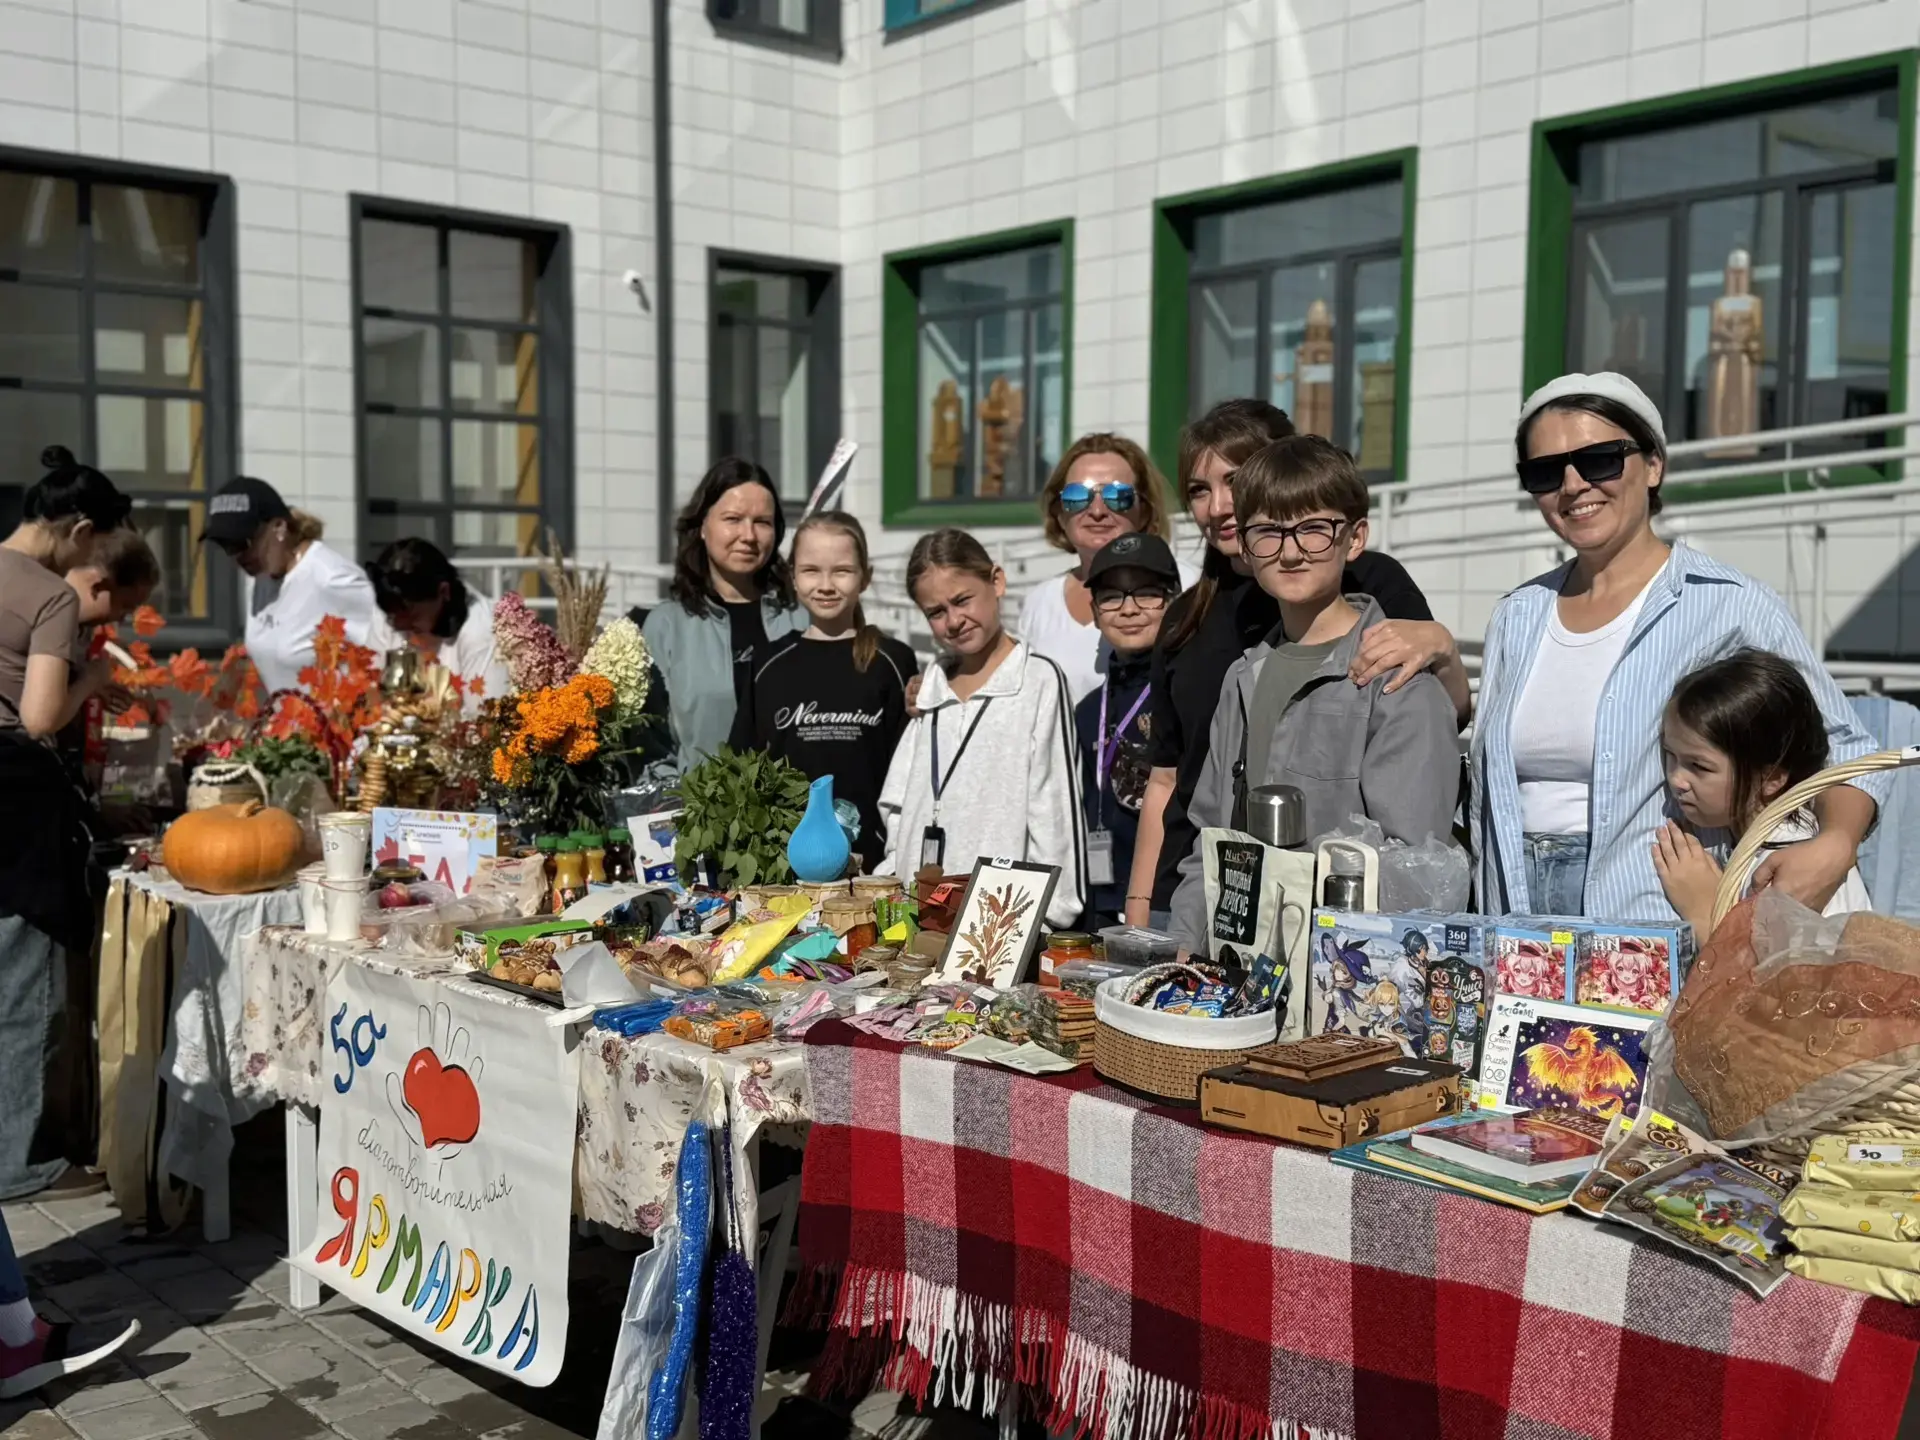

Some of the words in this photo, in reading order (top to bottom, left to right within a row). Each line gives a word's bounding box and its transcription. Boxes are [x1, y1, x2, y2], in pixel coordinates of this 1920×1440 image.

[775, 701, 883, 730] Nevermind
[1447, 930, 1467, 941] 360
[1485, 1054, 1508, 1066] Puzzle
[1859, 1148, 1882, 1160] 30
[357, 1118, 514, 1212] благотворительная
[316, 1166, 540, 1371] ЯРМАРКА
